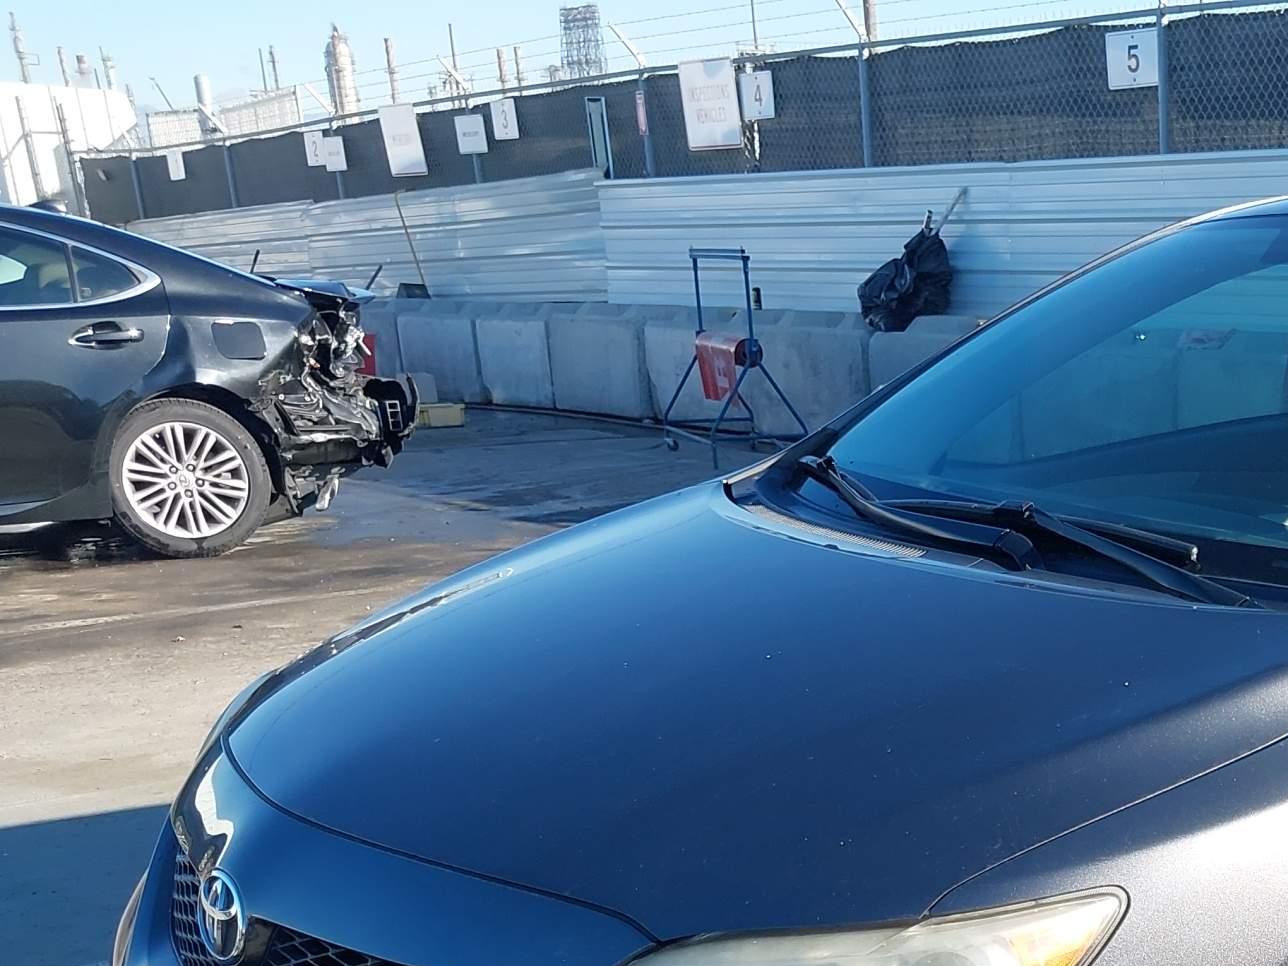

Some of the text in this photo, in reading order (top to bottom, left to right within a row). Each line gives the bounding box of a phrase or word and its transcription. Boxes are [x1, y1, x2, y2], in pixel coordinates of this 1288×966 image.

[1127, 44, 1140, 73] 5
[754, 83, 764, 107] 4
[501, 109, 509, 129] 3
